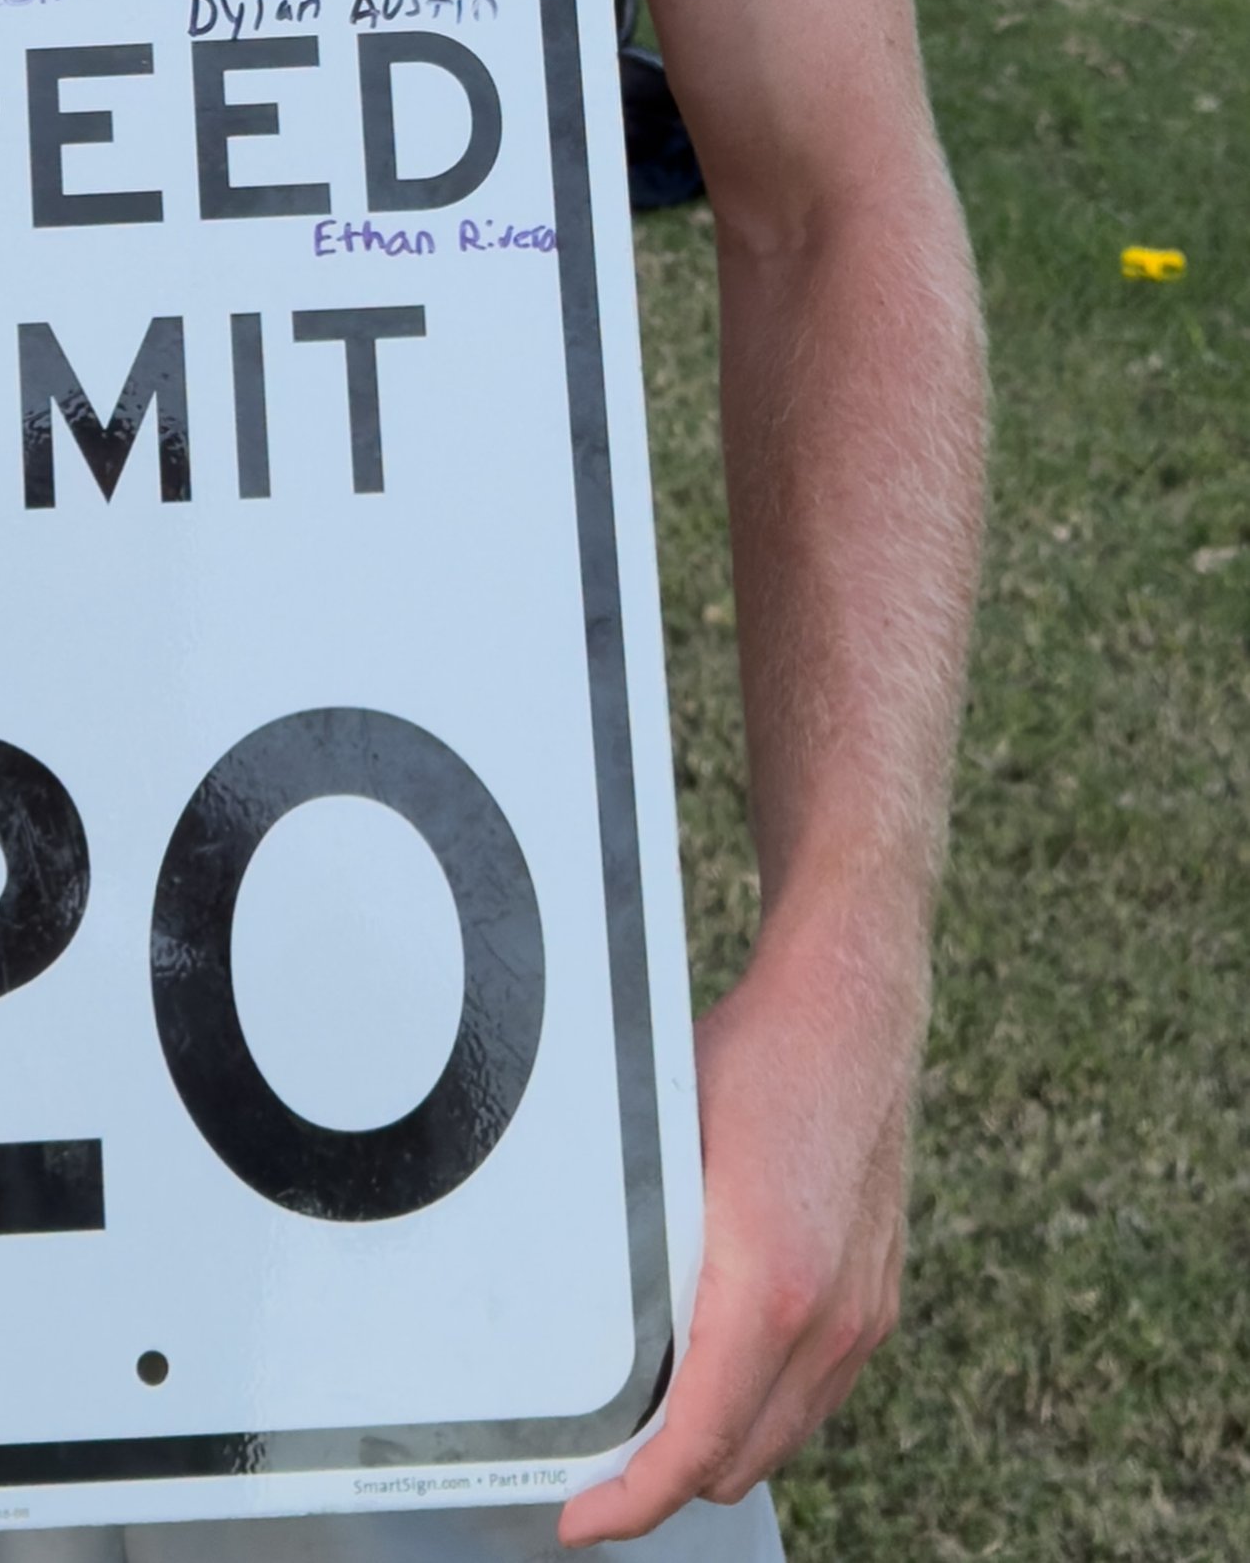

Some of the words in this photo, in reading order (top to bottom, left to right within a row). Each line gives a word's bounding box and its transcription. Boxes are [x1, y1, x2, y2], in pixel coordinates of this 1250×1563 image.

[313, 220, 436, 257] Ethan
[353, 1476, 471, 1496] SmartSign.com
[489, 1473, 519, 1488] Part
